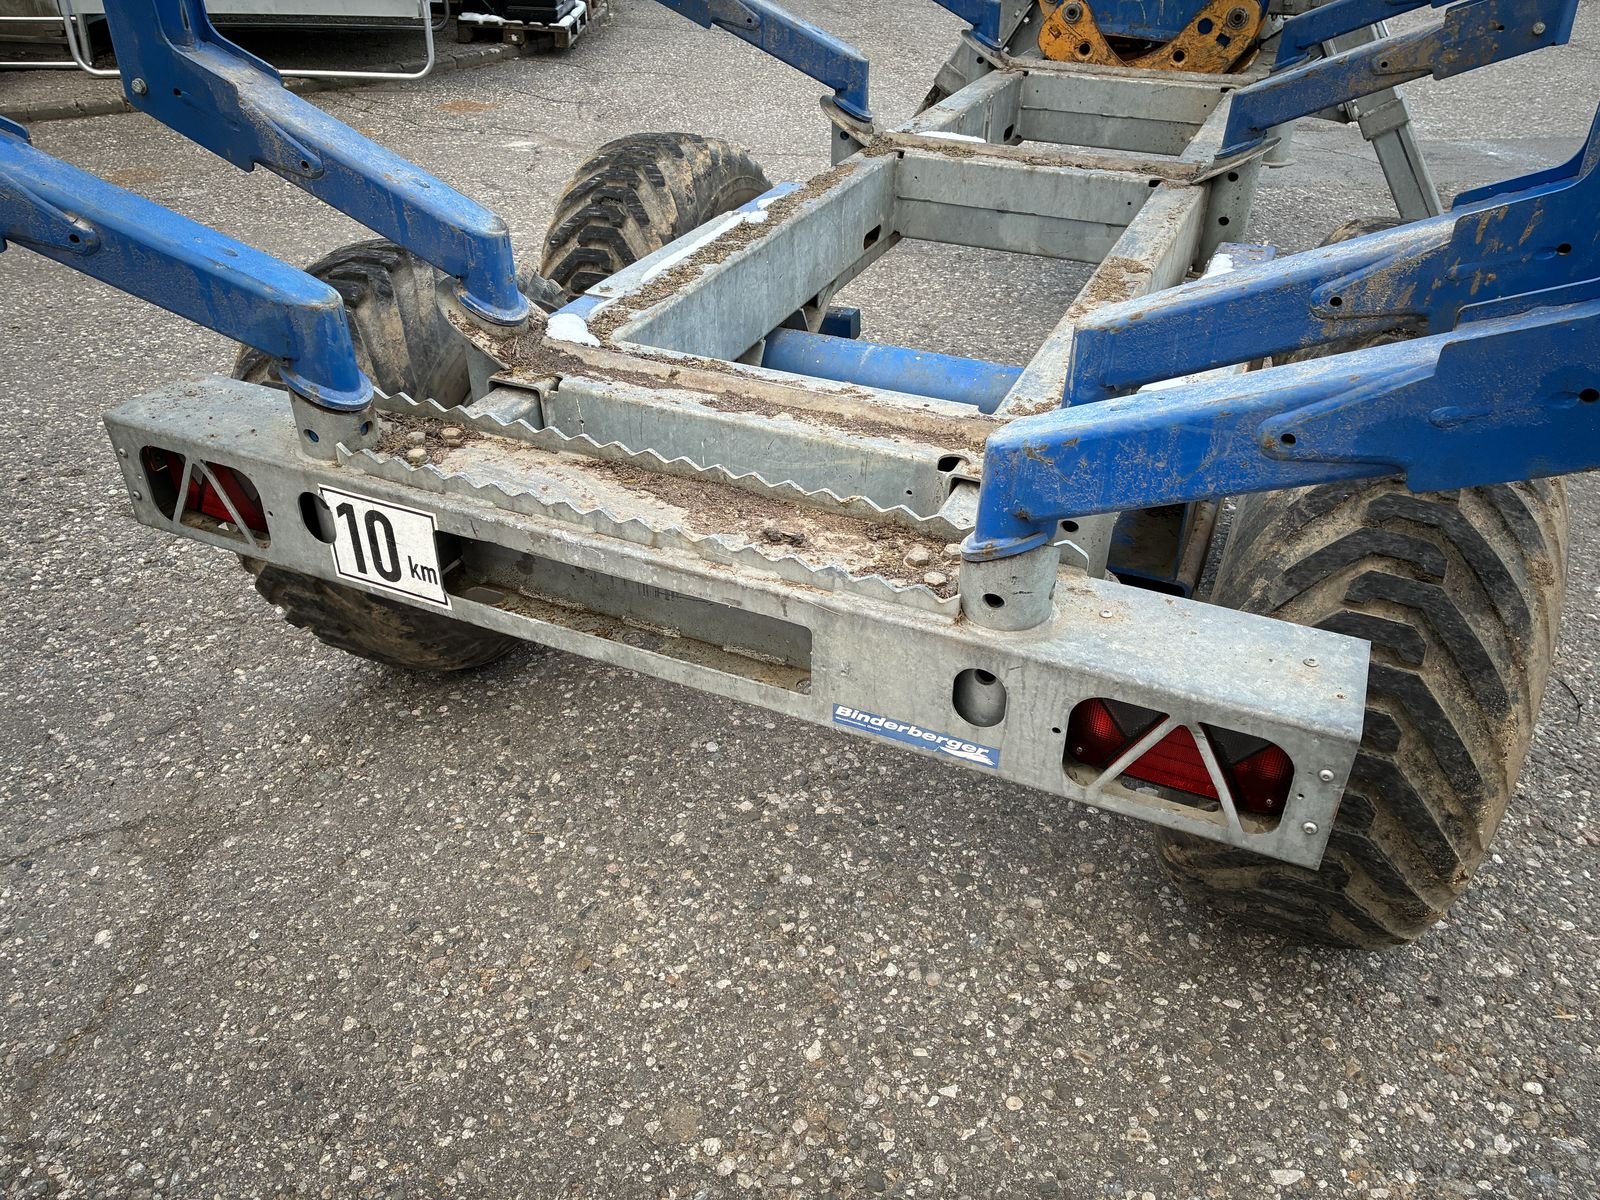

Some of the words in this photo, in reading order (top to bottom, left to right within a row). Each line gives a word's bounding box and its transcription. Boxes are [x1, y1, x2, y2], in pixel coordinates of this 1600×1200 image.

[336, 502, 402, 582] 10
[408, 555, 438, 585] km
[835, 705, 990, 756] Binderberger
